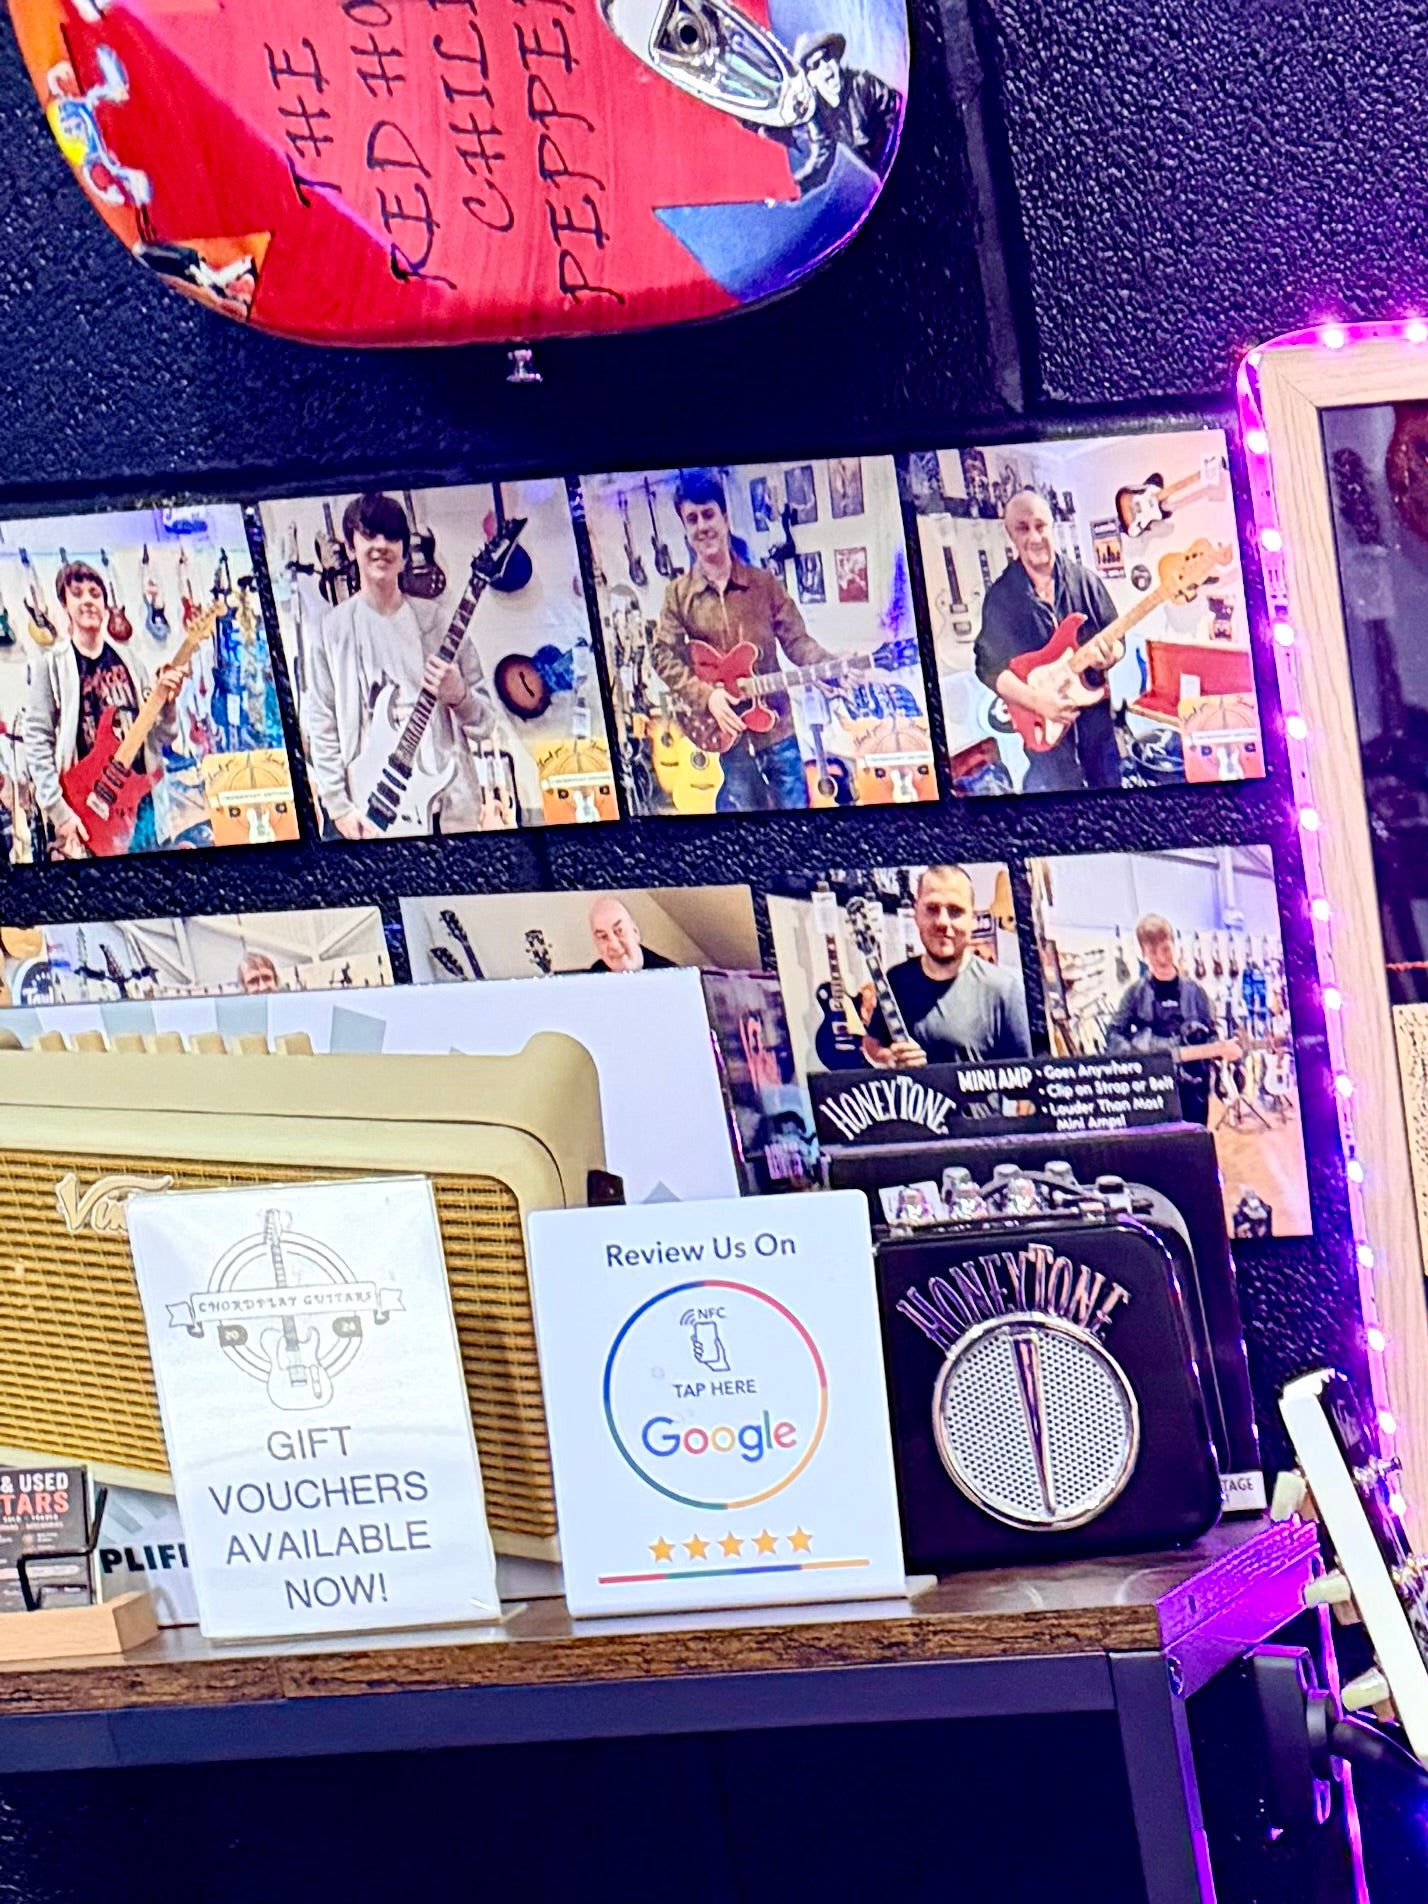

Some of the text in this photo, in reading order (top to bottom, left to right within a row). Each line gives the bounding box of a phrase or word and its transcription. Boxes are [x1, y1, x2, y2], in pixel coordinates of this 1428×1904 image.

[818, 1074, 958, 1141] HONEYTONE
[605, 1232, 797, 1268] Review Us On
[697, 1306, 727, 1320] NFC
[895, 1242, 1133, 1360] HONEYTONE
[672, 1379, 757, 1399] TAP HERE
[266, 1425, 352, 1461] GIFT
[641, 1409, 797, 1464] Google
[19, 1471, 69, 1493] USED
[207, 1470, 429, 1516] VOUCHERS
[225, 1519, 432, 1566] AVAILABLE
[284, 1572, 389, 1611] NOW!
